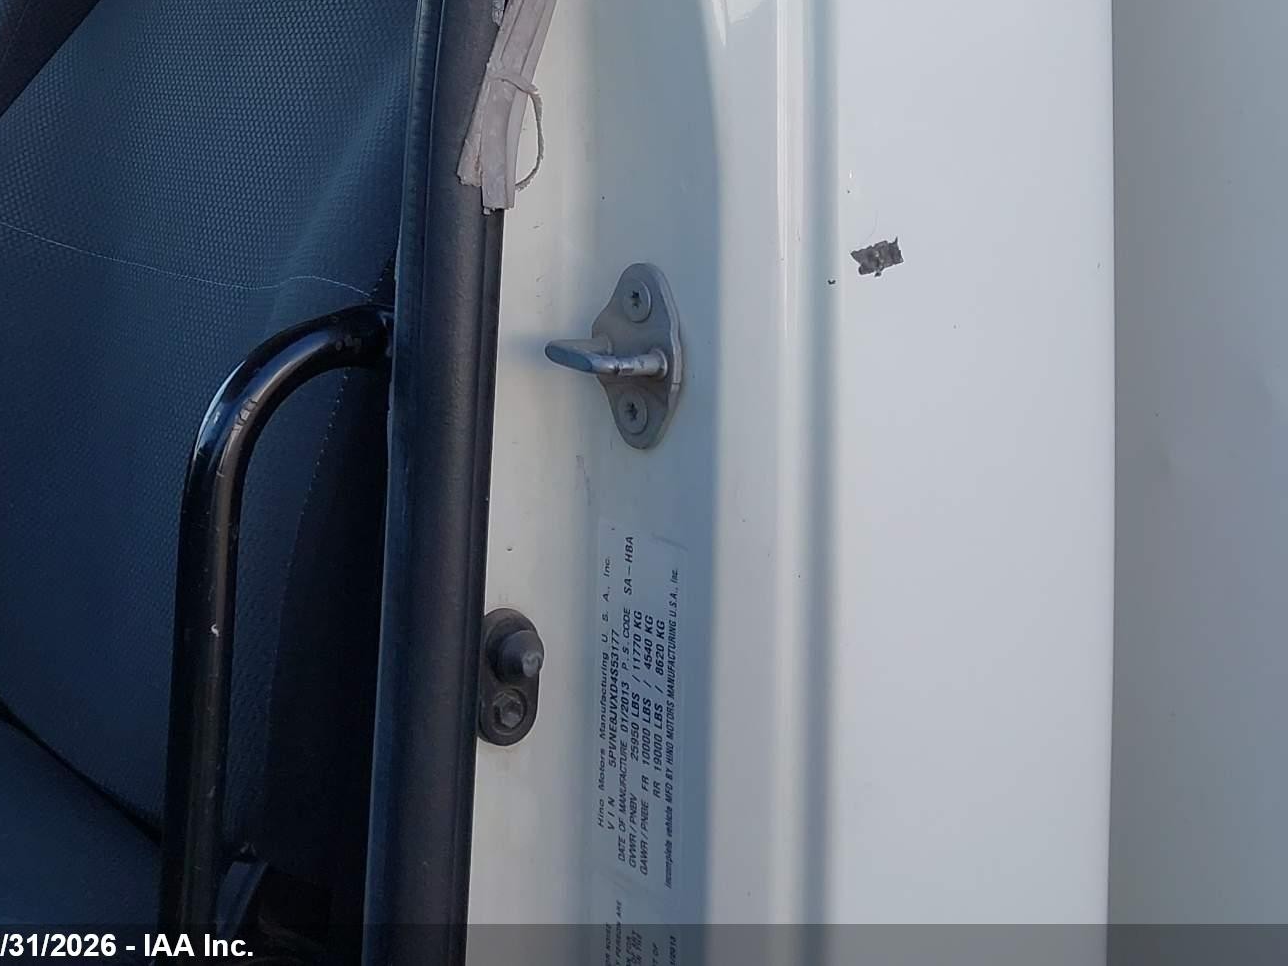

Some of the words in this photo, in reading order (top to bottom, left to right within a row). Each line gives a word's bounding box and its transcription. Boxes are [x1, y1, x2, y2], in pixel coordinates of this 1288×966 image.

[633, 610, 642, 629] KG
[645, 614, 653, 634] KG
[656, 619, 665, 639] KG
[644, 639, 652, 670] 4540
[656, 644, 664, 676] 8620
[667, 620, 676, 699] MANUFACTURING
[599, 652, 609, 740] Manufacturing
[608, 628, 619, 768] 5PVNE8JVXD4S53177
[620, 681, 629, 733] 01/2013
[632, 692, 640, 718] LBS
[642, 698, 651, 724] LBS
[654, 703, 663, 729] LBS
[666, 700, 674, 739] MOTORS
[631, 722, 639, 762] 25950
[642, 728, 651, 766] 10000
[653, 734, 662, 772] 19000
[619, 740, 628, 814] MANUFACTURE
[641, 775, 649, 792] FR
[653, 781, 661, 798] RR
[665, 768, 673, 780] BY
[619, 817, 626, 832] OF
